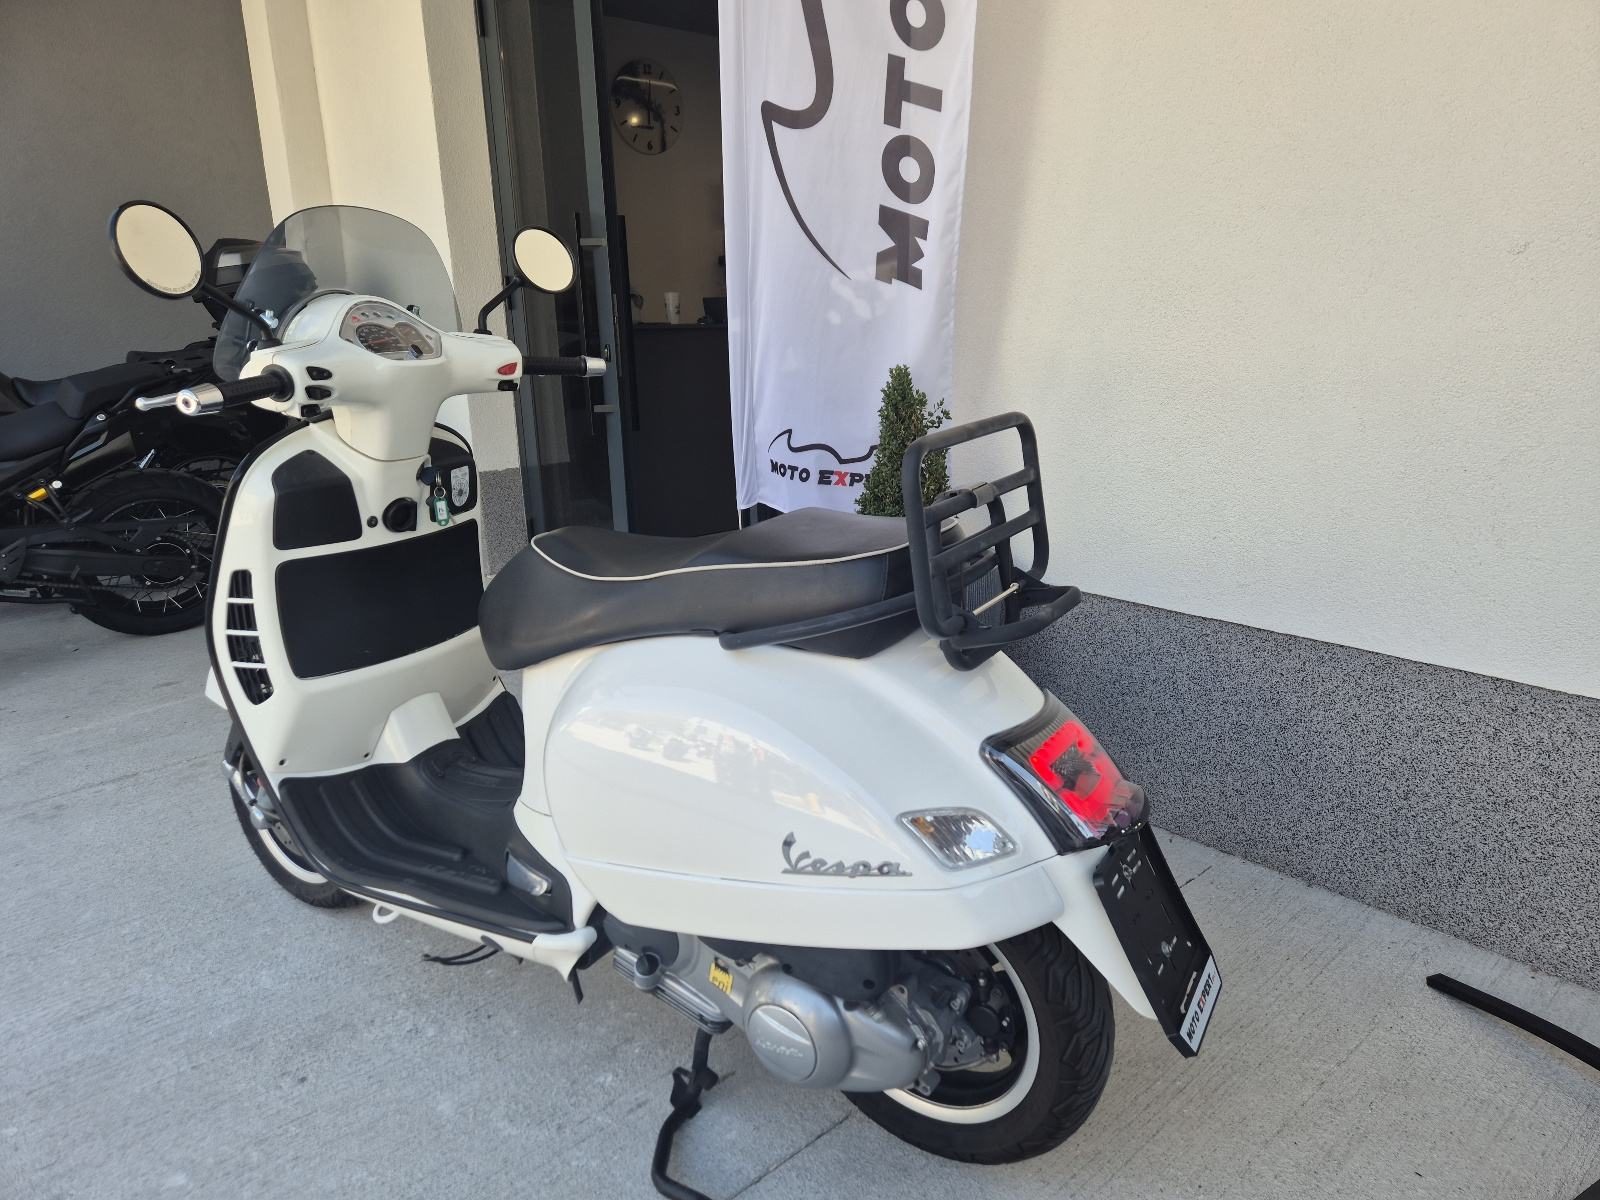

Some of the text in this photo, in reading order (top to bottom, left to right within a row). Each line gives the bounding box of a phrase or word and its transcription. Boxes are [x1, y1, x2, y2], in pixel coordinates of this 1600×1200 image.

[875, 0, 945, 290] MOTO
[770, 458, 871, 487] MOTO EXP
[781, 831, 913, 878] Vespa
[1186, 1011, 1200, 1043] MOTO
